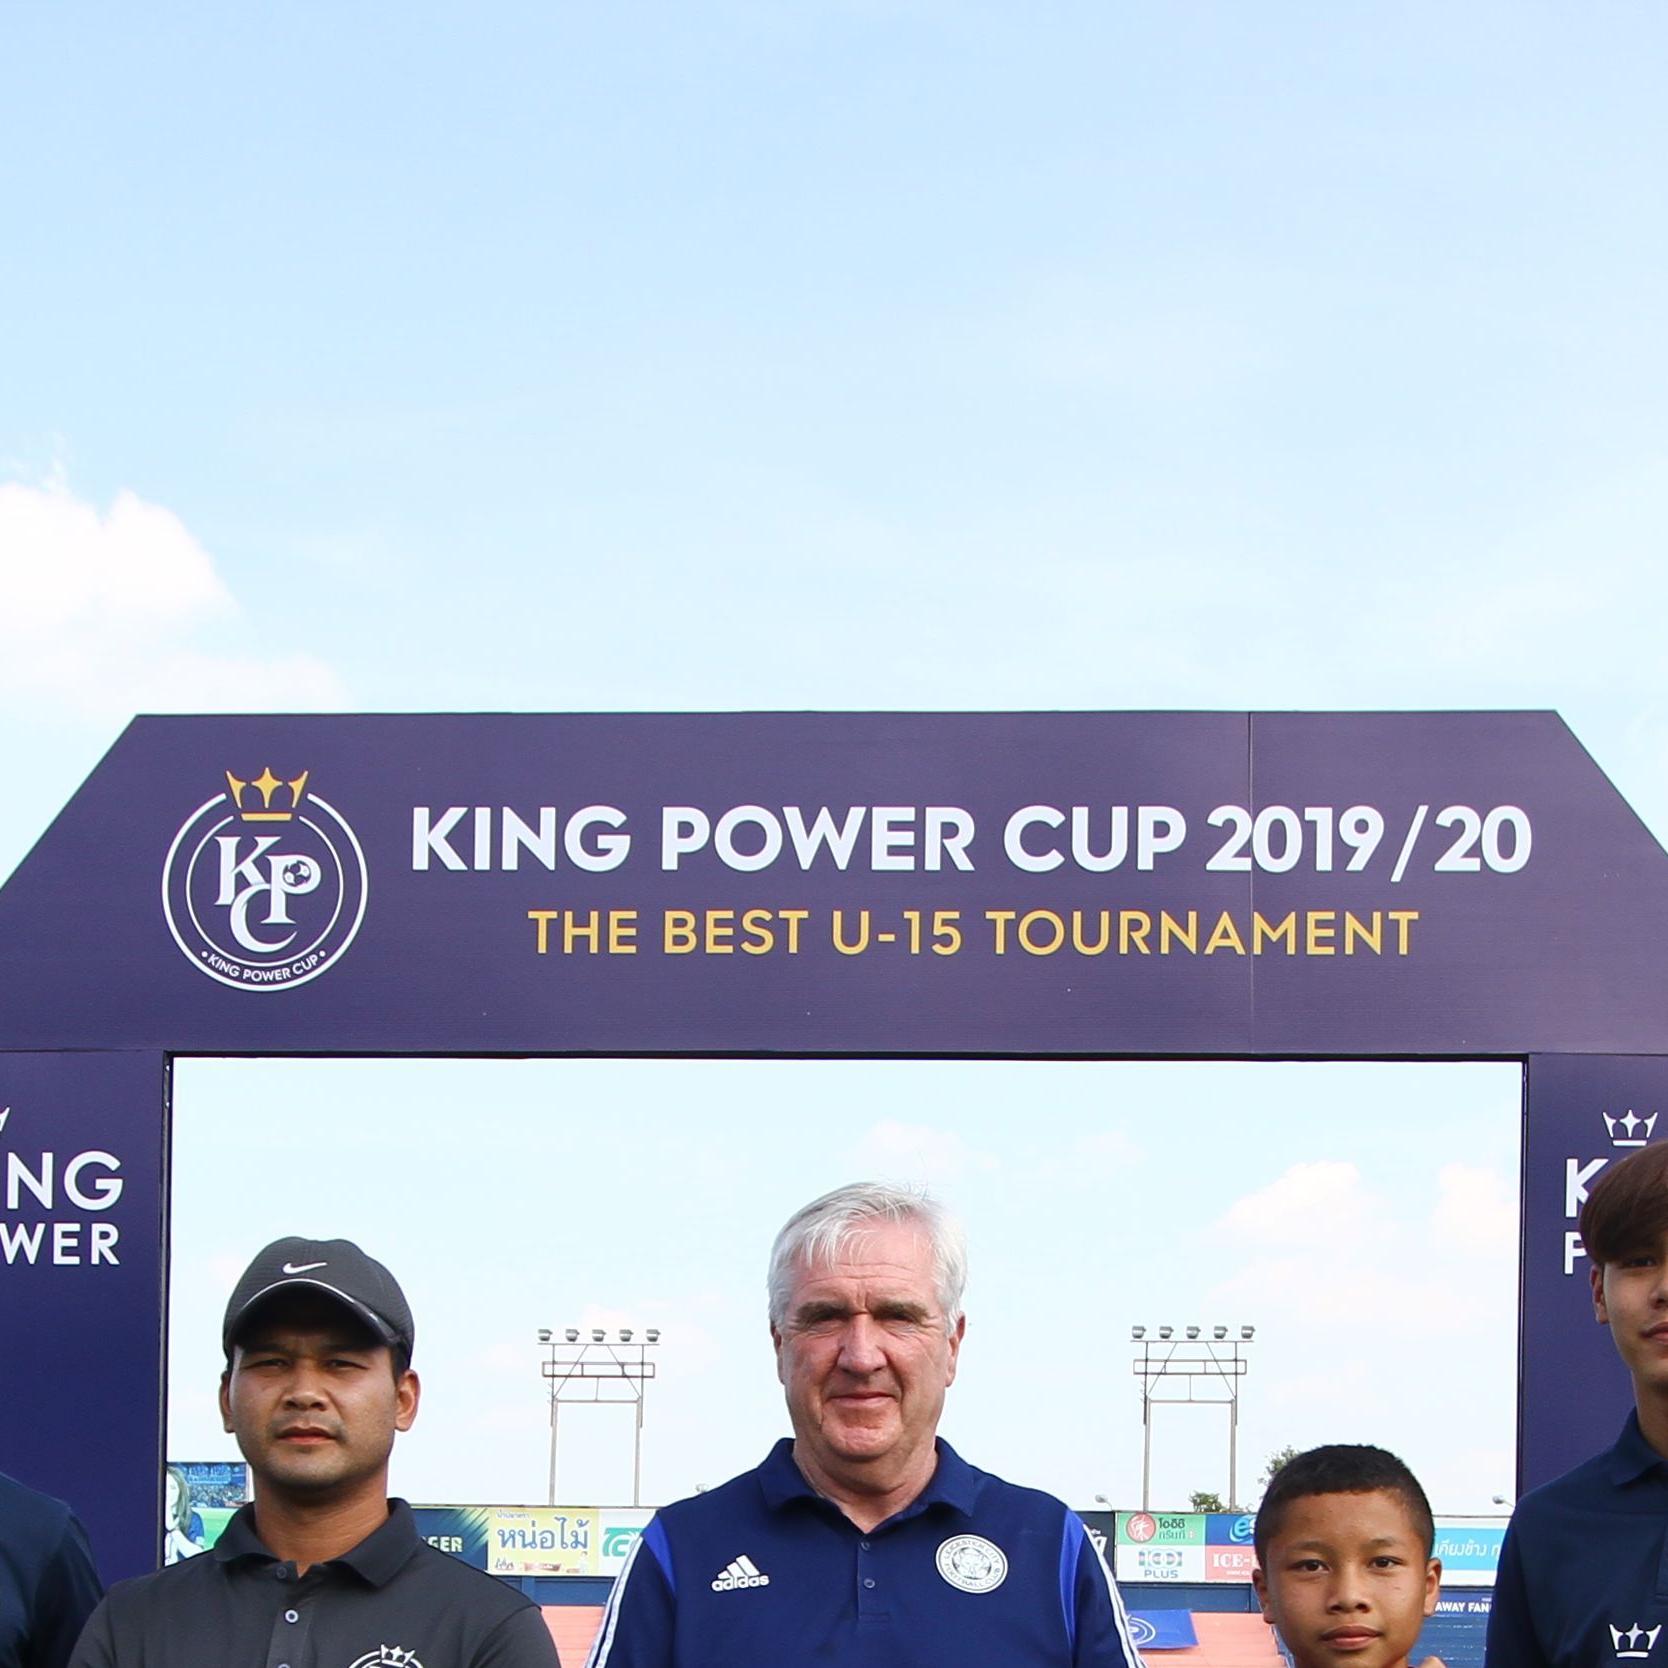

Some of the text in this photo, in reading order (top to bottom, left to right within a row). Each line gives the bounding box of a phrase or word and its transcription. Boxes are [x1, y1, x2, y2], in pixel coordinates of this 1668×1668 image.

[412, 804, 1533, 883] KING POWER CUP 2019/20
[526, 907, 1421, 956] THE BEST U-15 TOURNAMENT
[207, 953, 320, 982] KING POWER CUP
[497, 1516, 591, 1550] หน่อไม้
[711, 1573, 770, 1593] adidas
[1144, 1569, 1179, 1579] PLUS
[1434, 1601, 1492, 1613] AWAY FAN
